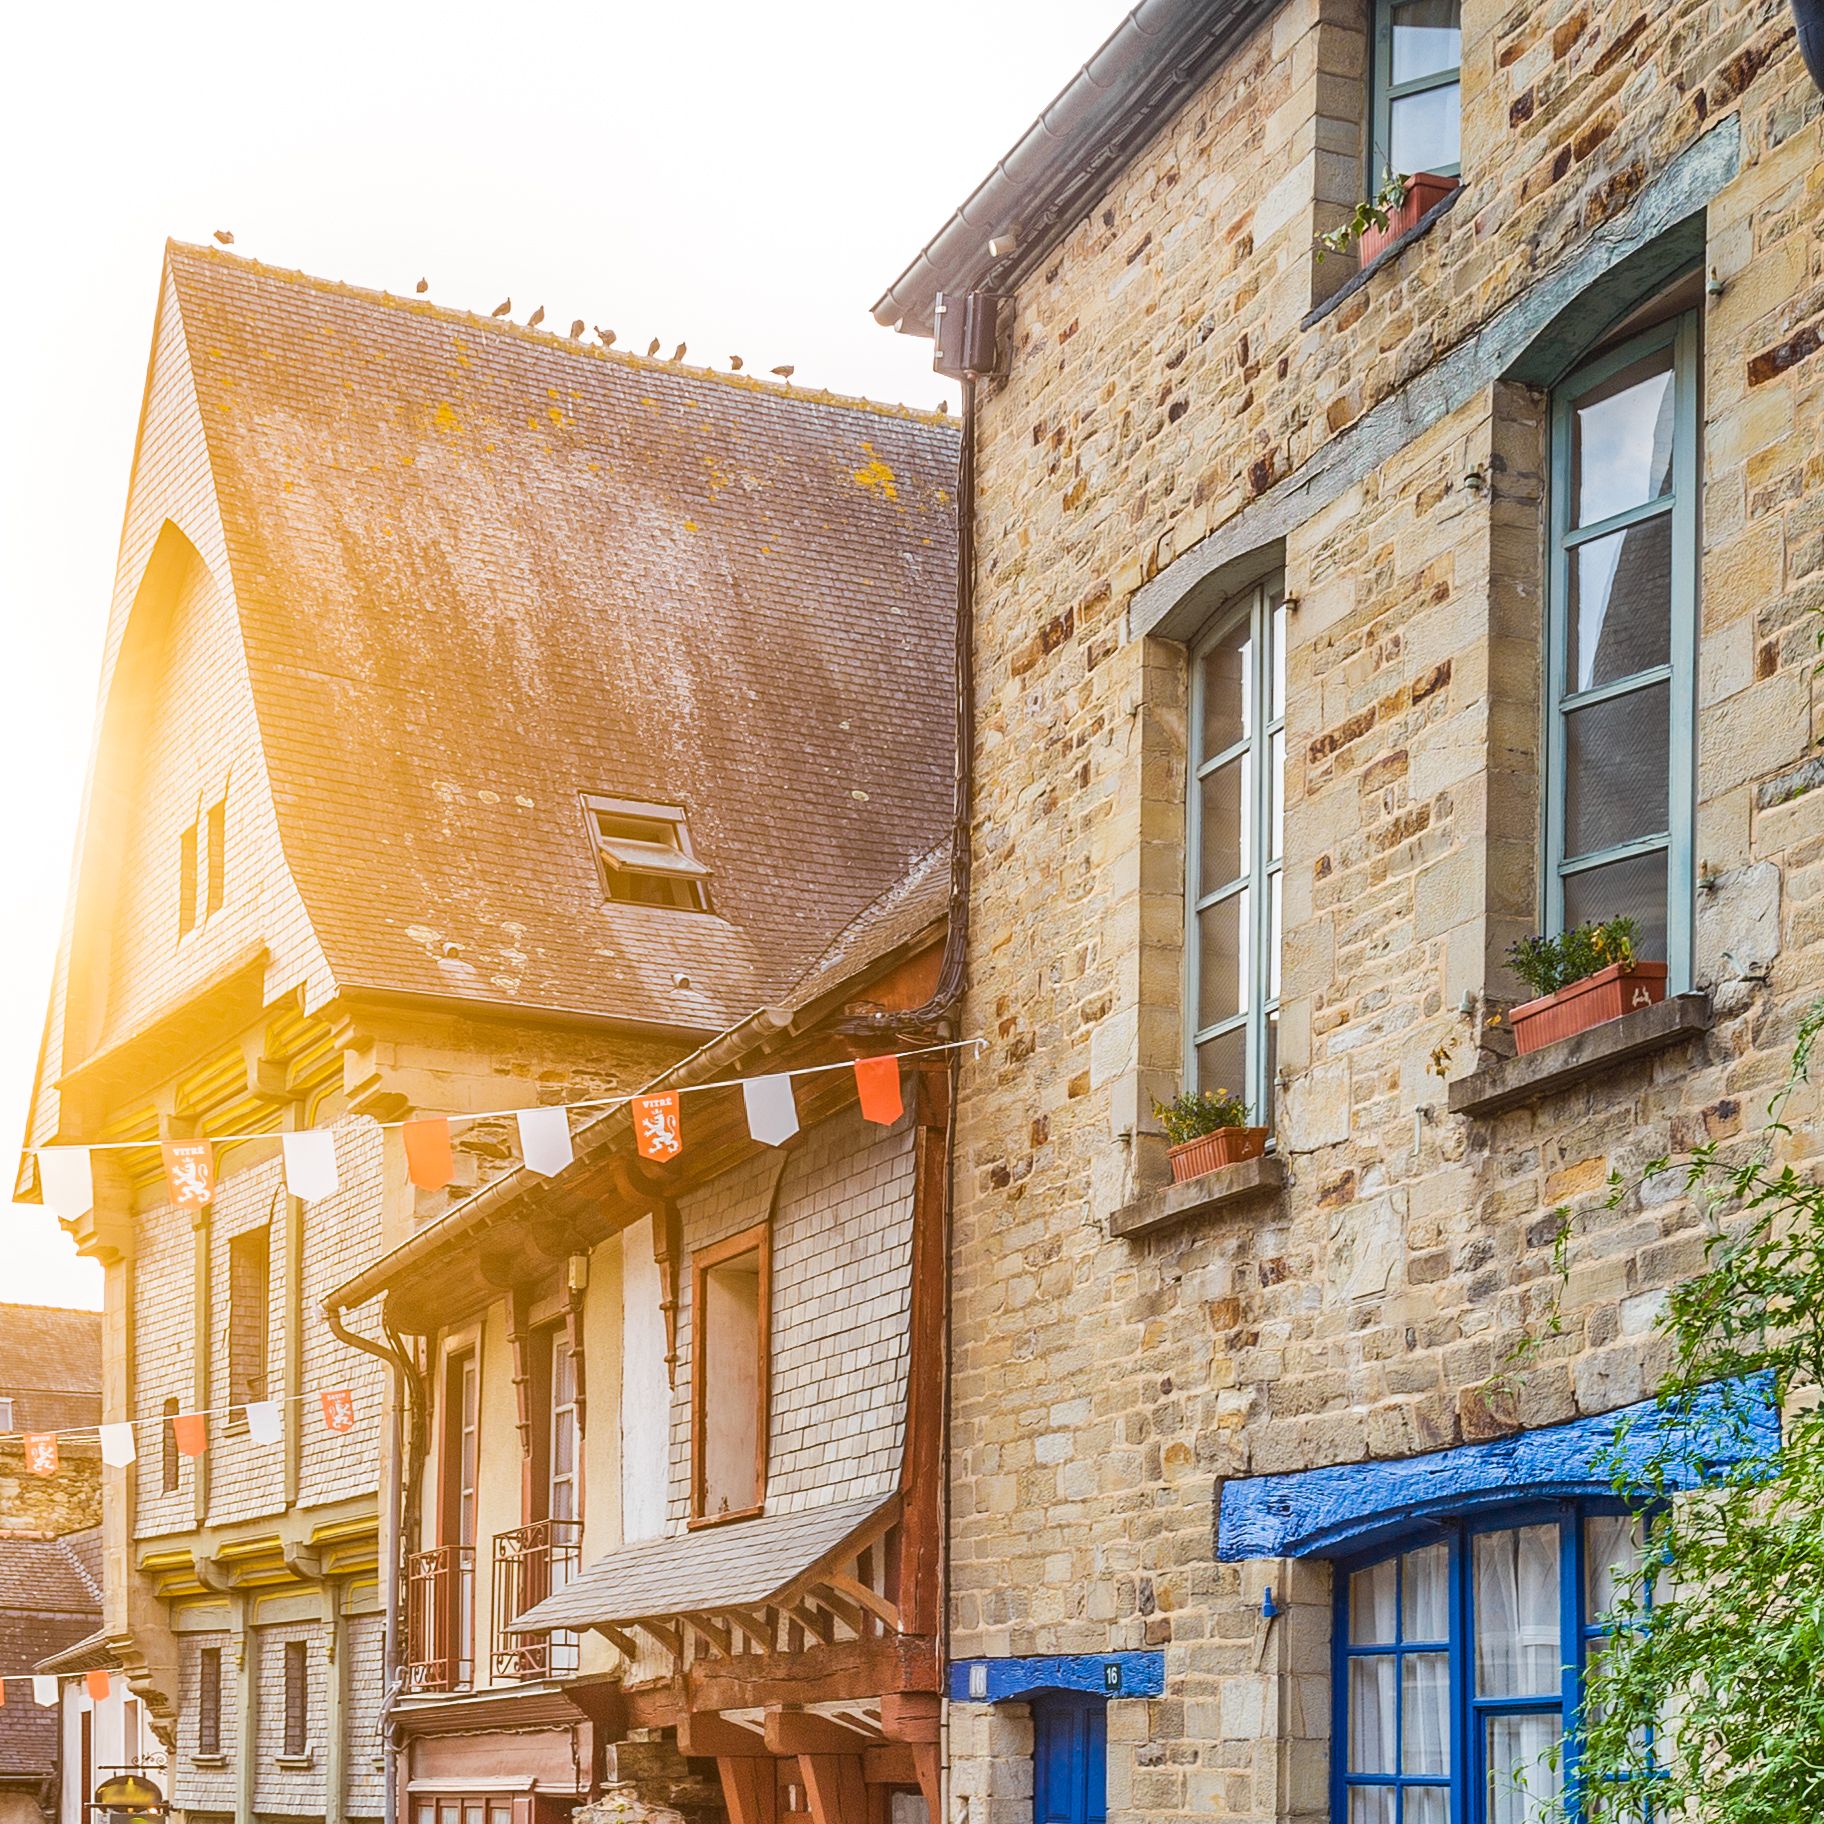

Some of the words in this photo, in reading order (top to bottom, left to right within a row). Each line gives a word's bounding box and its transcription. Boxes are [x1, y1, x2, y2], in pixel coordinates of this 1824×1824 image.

[643, 1097, 672, 1109] VITRÉ
[173, 1145, 204, 1156] VITRÉ
[1106, 1666, 1118, 1684] 16
